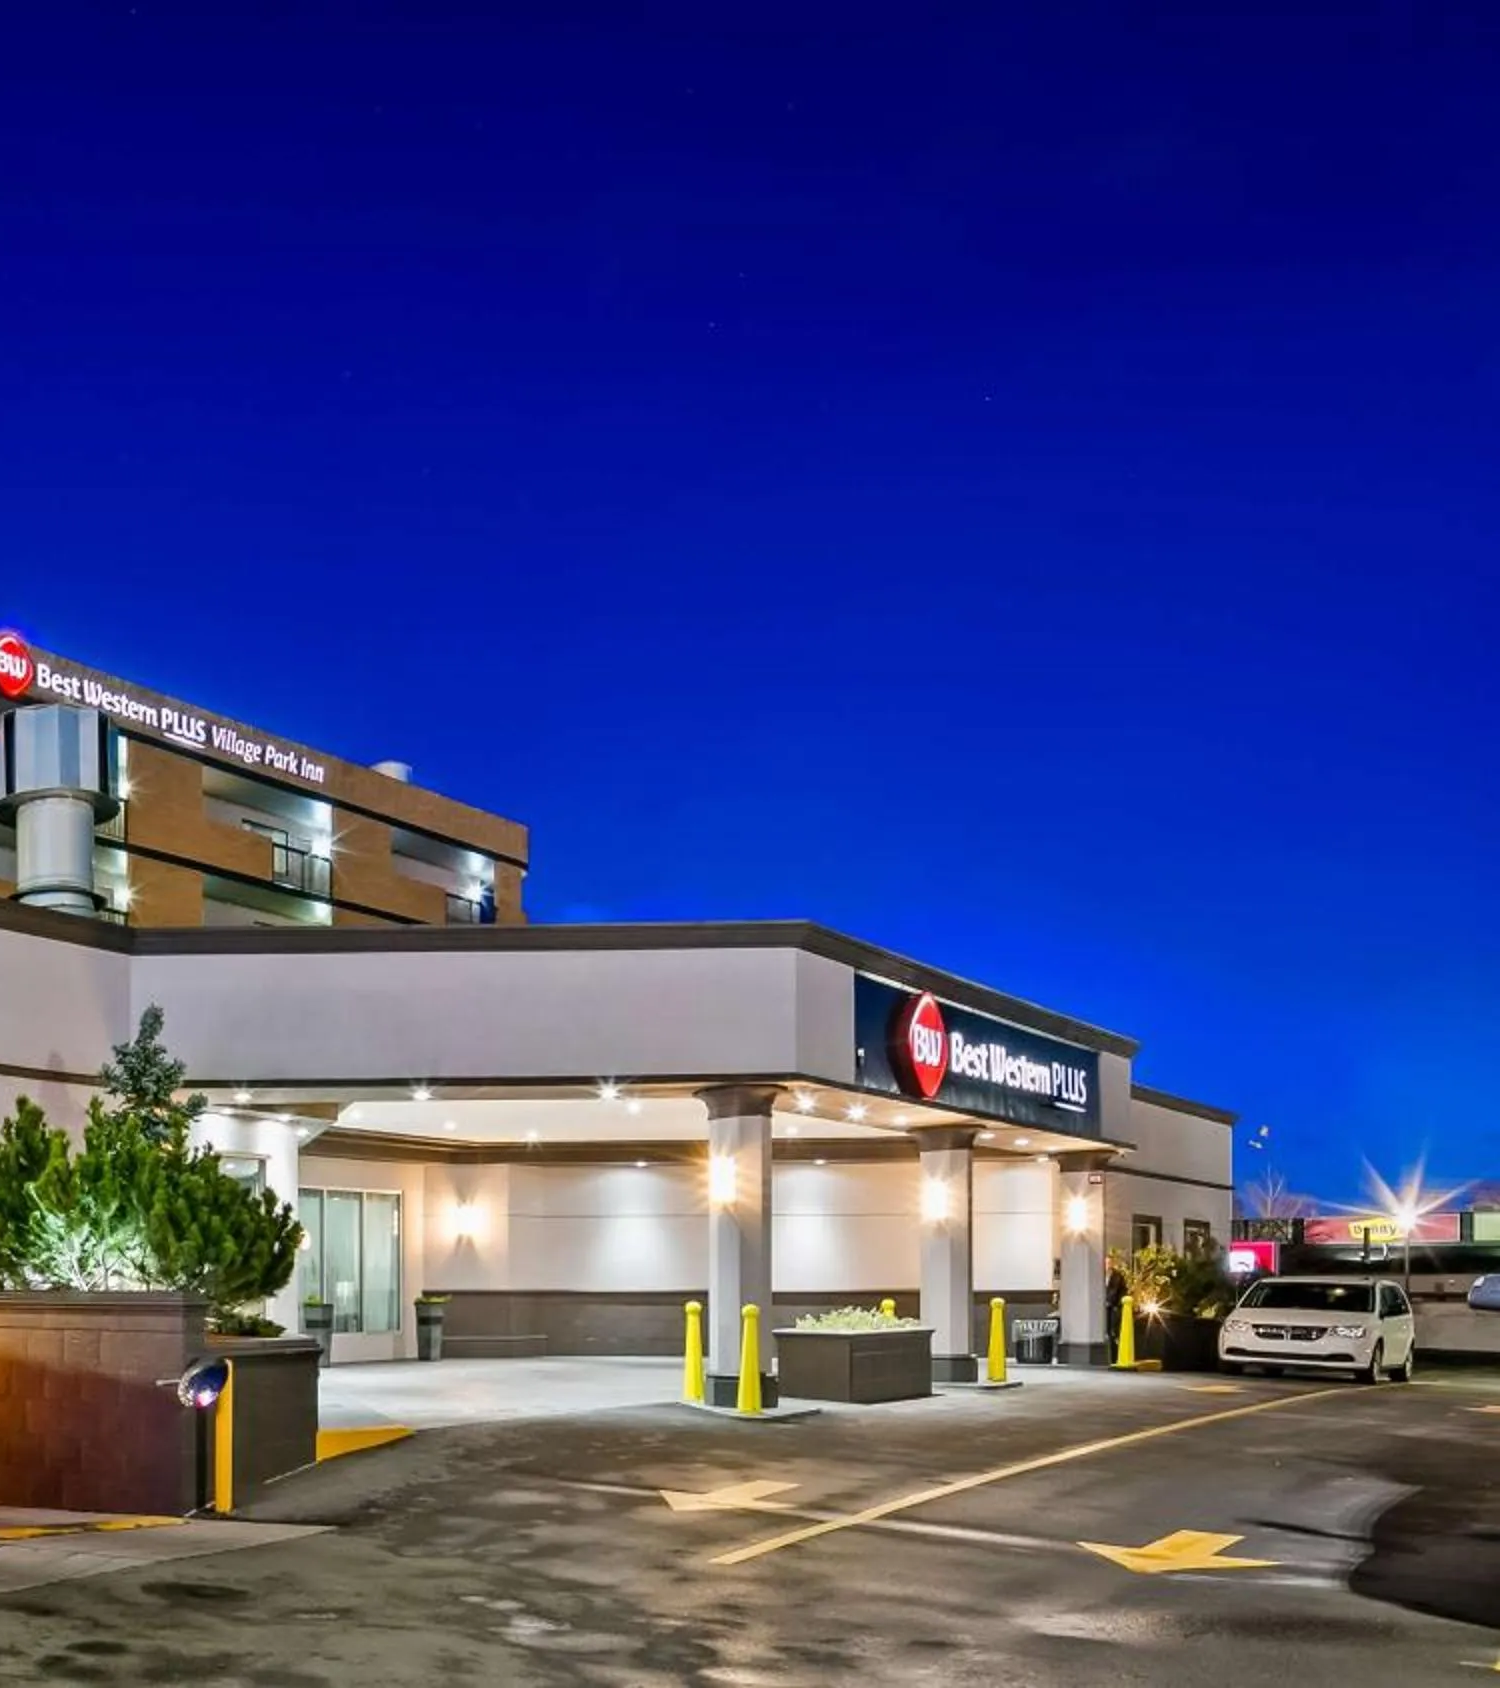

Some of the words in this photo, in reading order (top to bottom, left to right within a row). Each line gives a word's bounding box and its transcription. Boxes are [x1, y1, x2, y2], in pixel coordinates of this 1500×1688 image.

[37, 663, 81, 701] Best
[83, 679, 159, 727] Western
[160, 707, 207, 742] PLUS
[211, 725, 261, 763] Village
[264, 744, 299, 776] Park
[300, 757, 325, 784] Inn
[912, 1023, 943, 1067] BW
[949, 1032, 989, 1080] Best
[988, 1043, 1053, 1096] Western
[1052, 1061, 1087, 1104] PLUS
